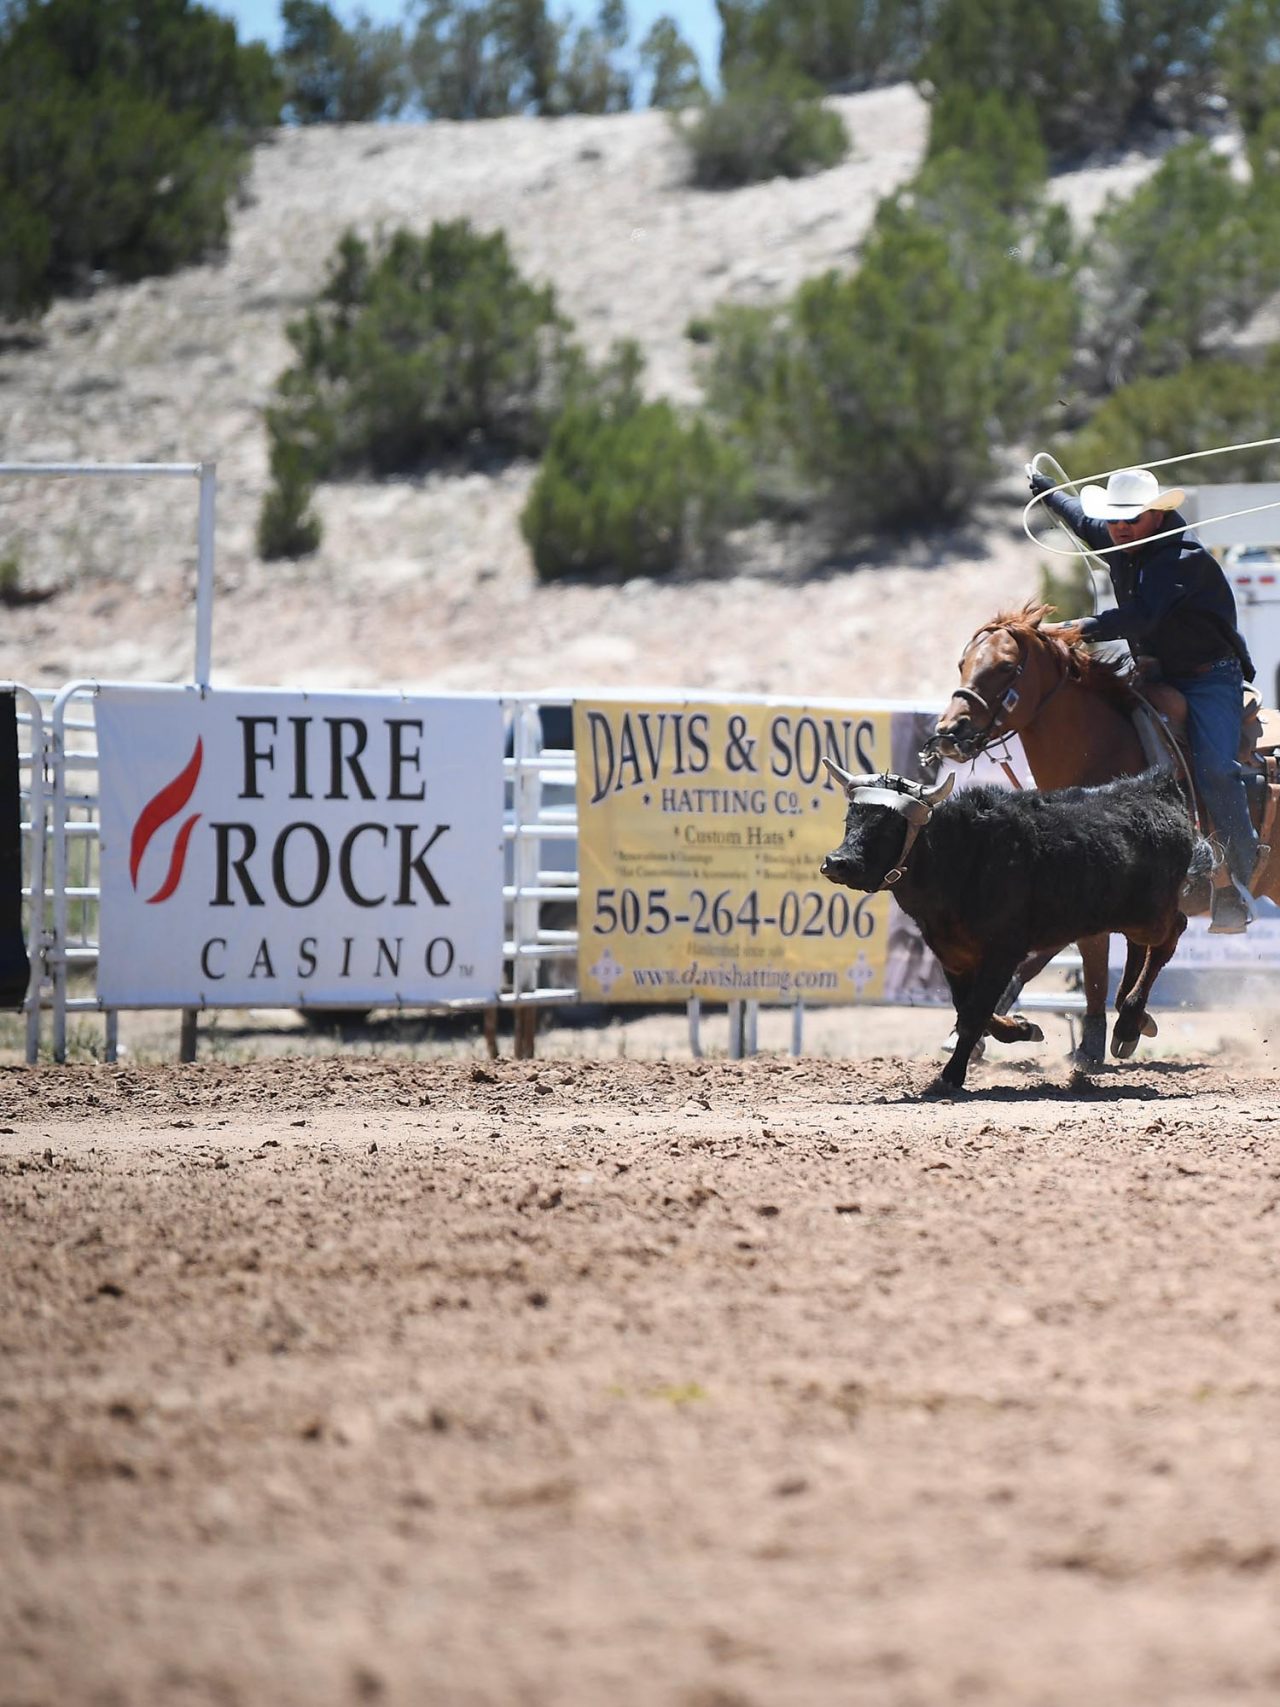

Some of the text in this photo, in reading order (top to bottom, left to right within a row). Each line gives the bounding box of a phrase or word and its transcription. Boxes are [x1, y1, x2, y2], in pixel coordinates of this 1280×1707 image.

[236, 716, 427, 801] FIRE
[587, 711, 875, 804] DAVIS & SONS
[662, 788, 766, 814] HATTING
[684, 824, 785, 846] Custom Hats
[208, 822, 451, 908] ROCK
[592, 888, 875, 938] 505-264-0206
[200, 937, 455, 980] CASINO
